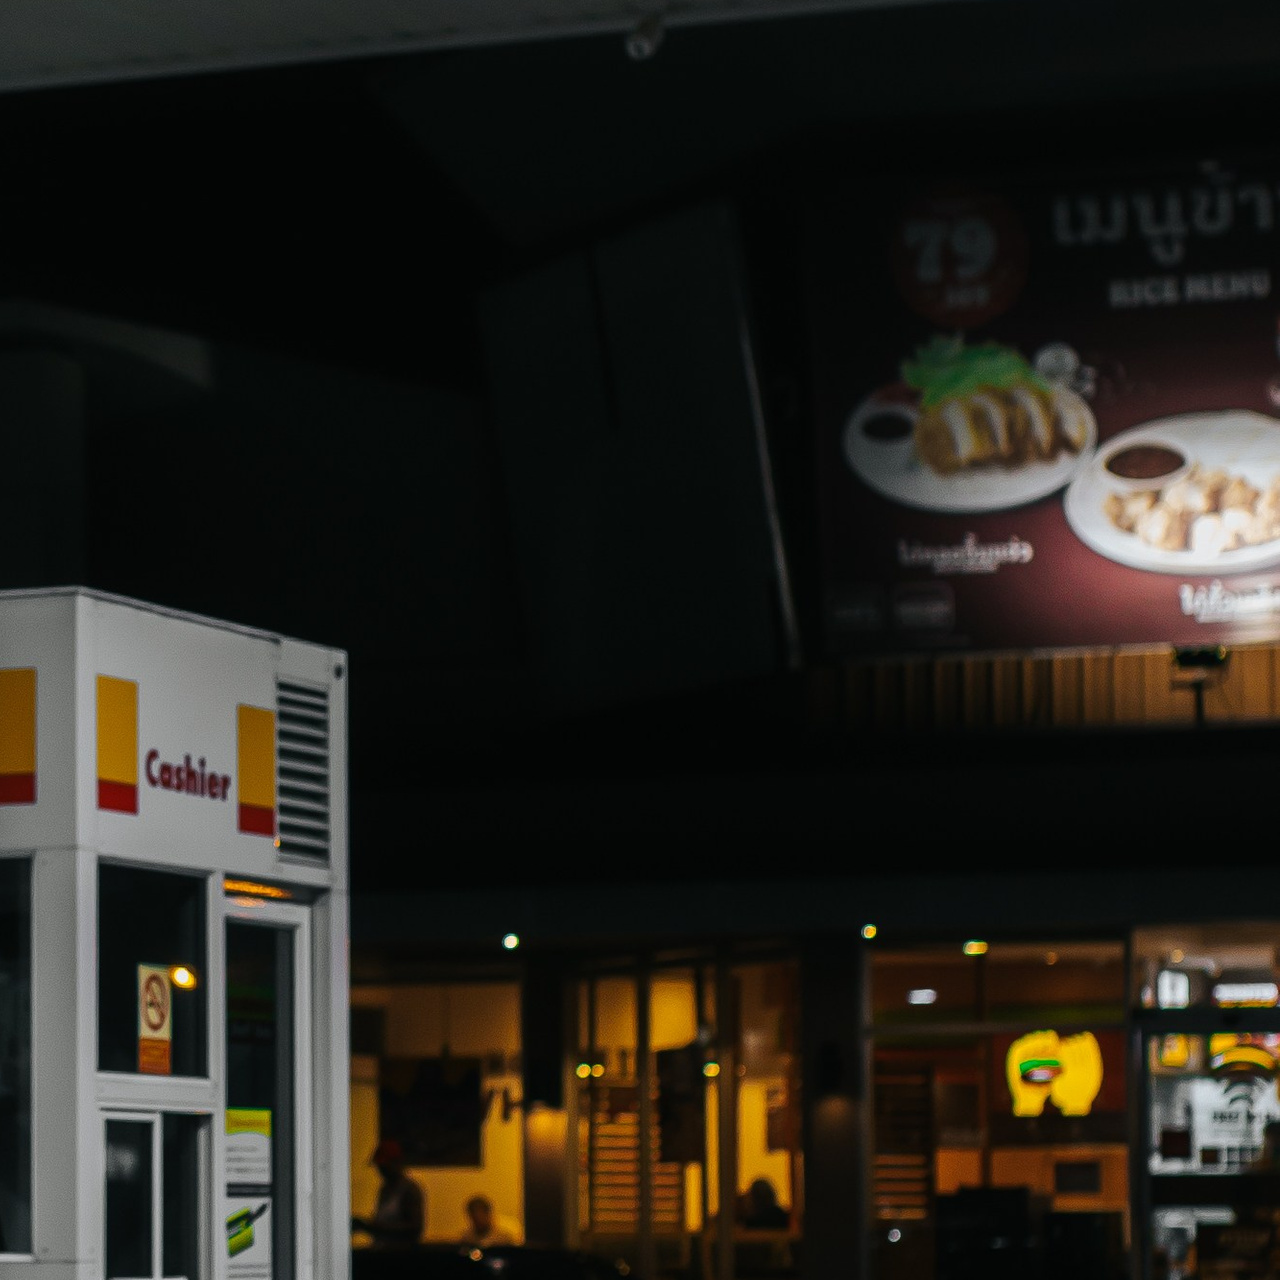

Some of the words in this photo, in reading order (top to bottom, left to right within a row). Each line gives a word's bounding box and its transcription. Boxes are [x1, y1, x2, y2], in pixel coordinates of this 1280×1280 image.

[1051, 158, 1280, 266] เมนูข้า
[902, 216, 998, 282] 79
[145, 749, 231, 802] Cashier
